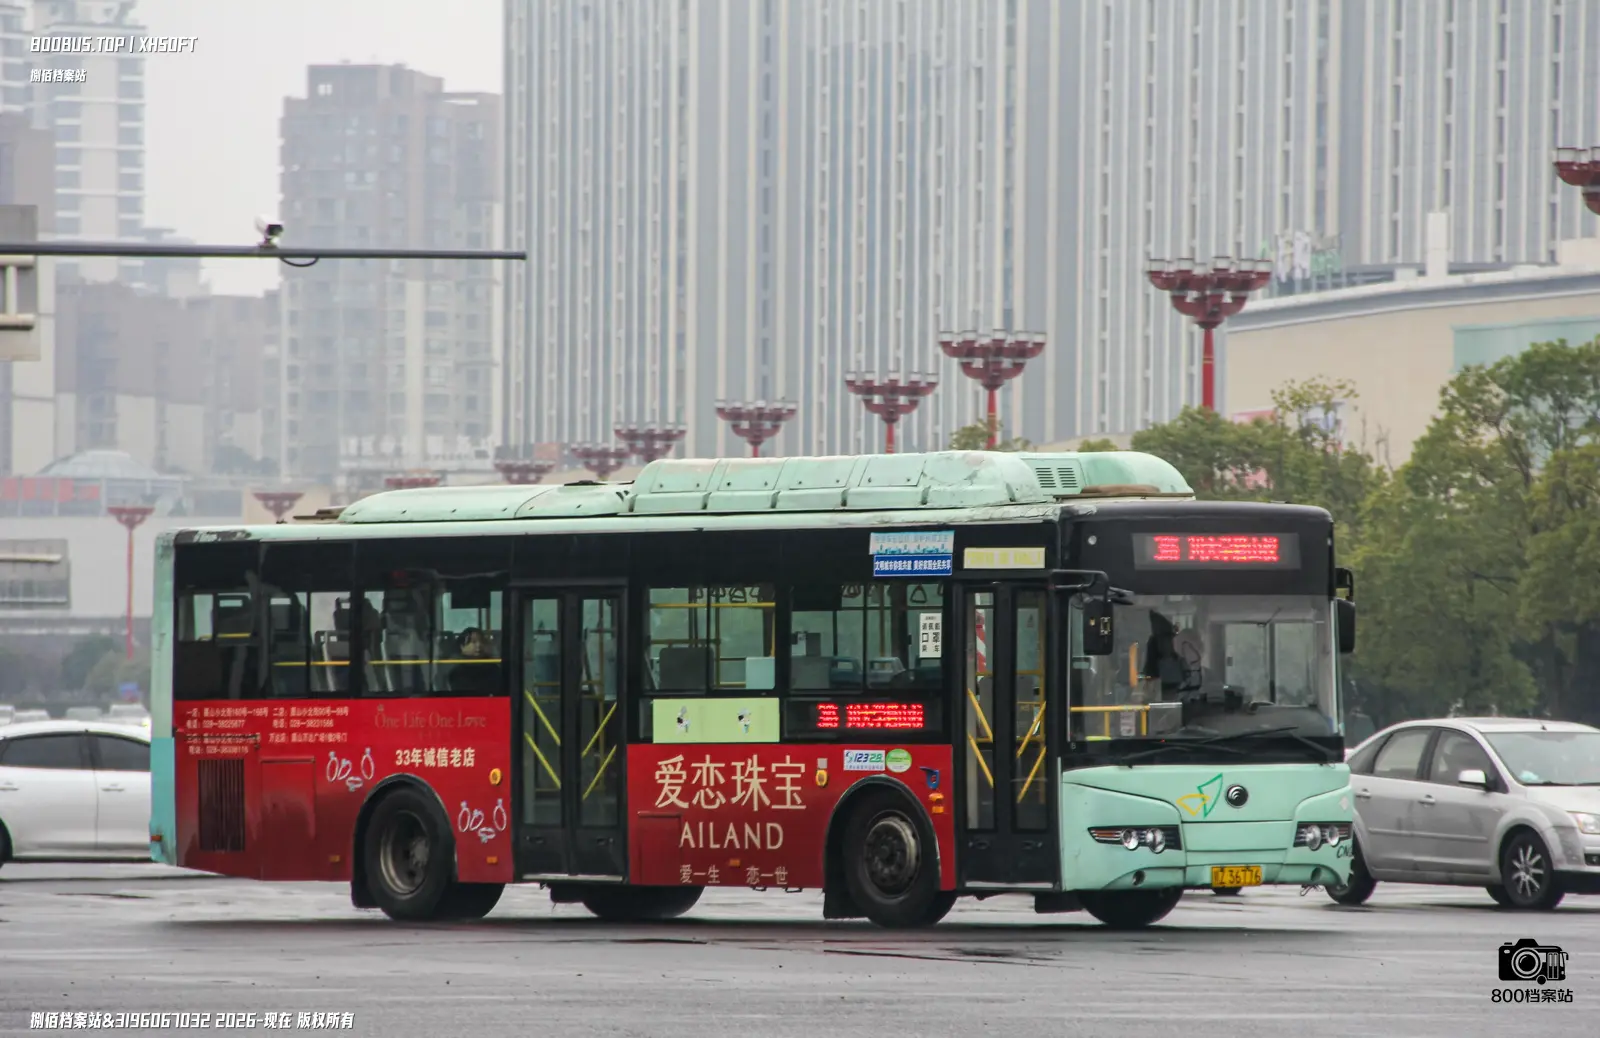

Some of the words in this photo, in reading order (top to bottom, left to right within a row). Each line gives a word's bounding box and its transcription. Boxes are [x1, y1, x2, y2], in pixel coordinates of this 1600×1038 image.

[395, 747, 476, 768] 33年诚信老店
[654, 754, 807, 812] 爱恋珠宝
[678, 821, 784, 850] AILAND
[679, 864, 721, 883] 爱一生
[745, 865, 788, 884] 恋一世
